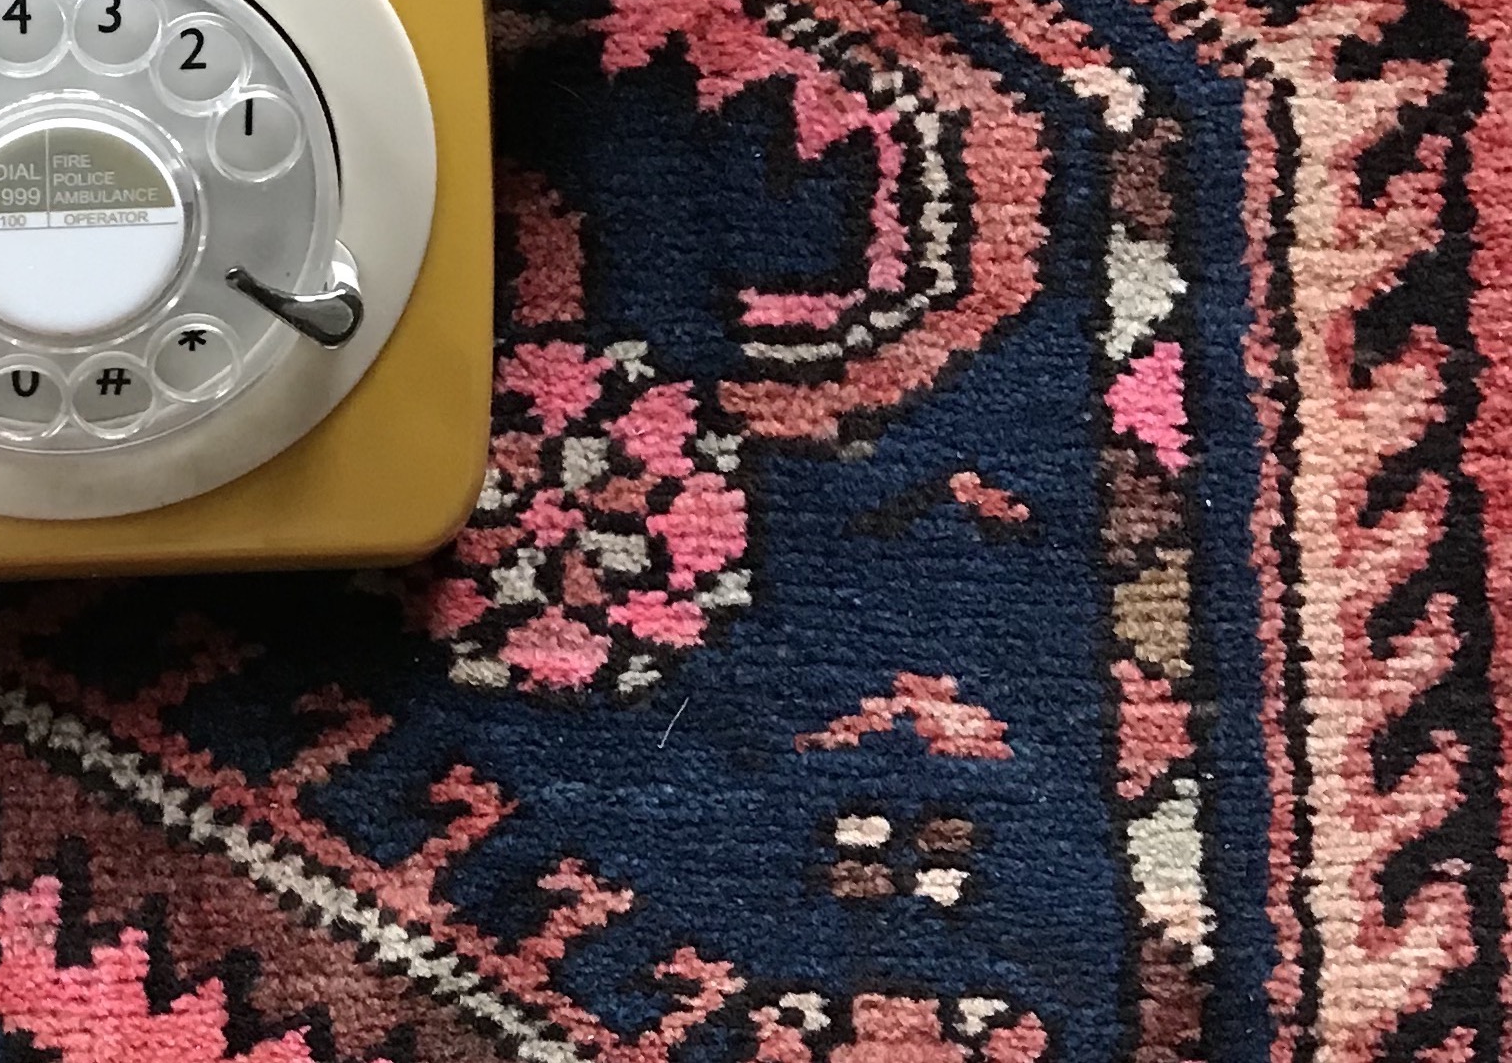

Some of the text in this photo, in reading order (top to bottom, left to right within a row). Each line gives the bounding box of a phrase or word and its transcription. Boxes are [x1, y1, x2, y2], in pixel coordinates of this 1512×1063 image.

[179, 27, 207, 71] 2
[244, 98, 254, 137] 1
[53, 155, 91, 168] FIRE
[54, 172, 115, 186] POLICE
[1, 188, 40, 206] 999
[54, 188, 158, 204] AMBULANCE
[0, 211, 149, 227] 100 OPERATOR
